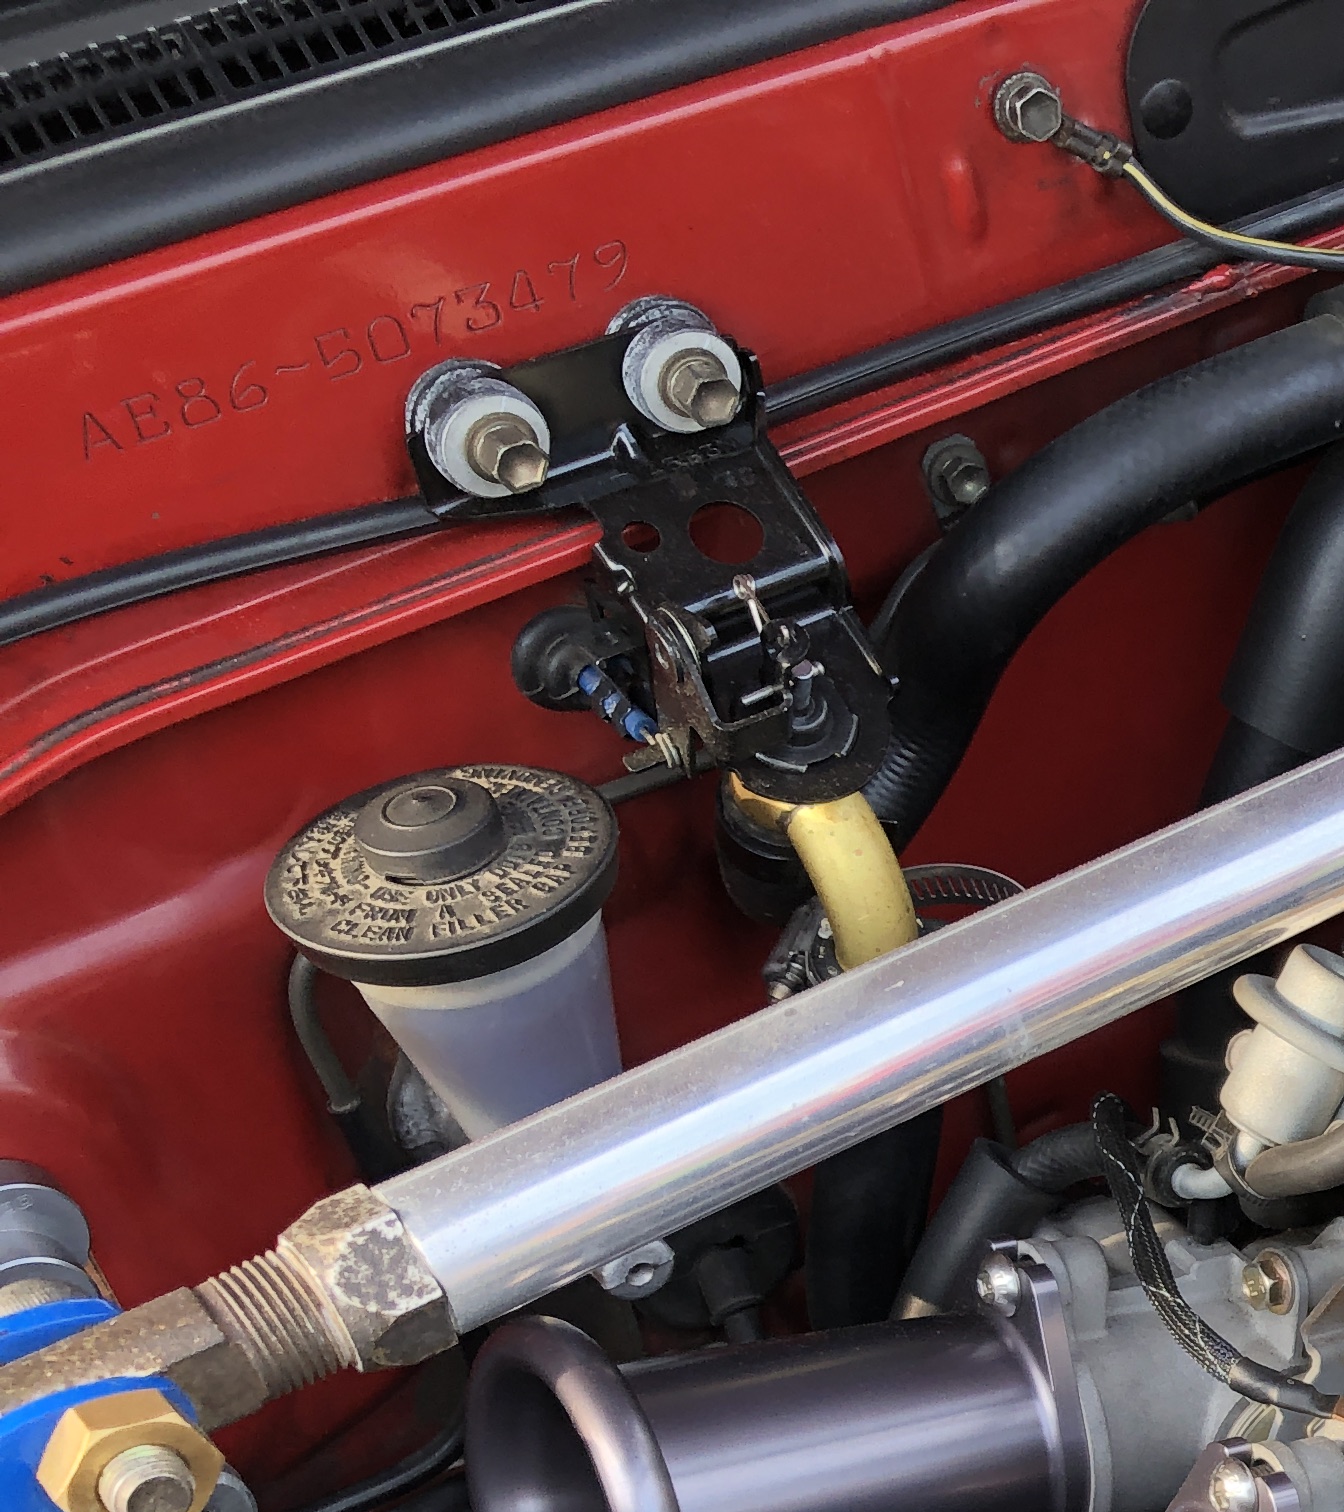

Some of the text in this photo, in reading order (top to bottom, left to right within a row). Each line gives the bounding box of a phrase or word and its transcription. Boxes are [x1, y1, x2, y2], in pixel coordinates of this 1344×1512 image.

[330, 919, 415, 942] CLEAN
[431, 898, 530, 939] FILLER
[531, 862, 575, 895] CAP
[425, 878, 483, 905] ONLY
[349, 902, 417, 924] FROM
[439, 904, 456, 920] A
